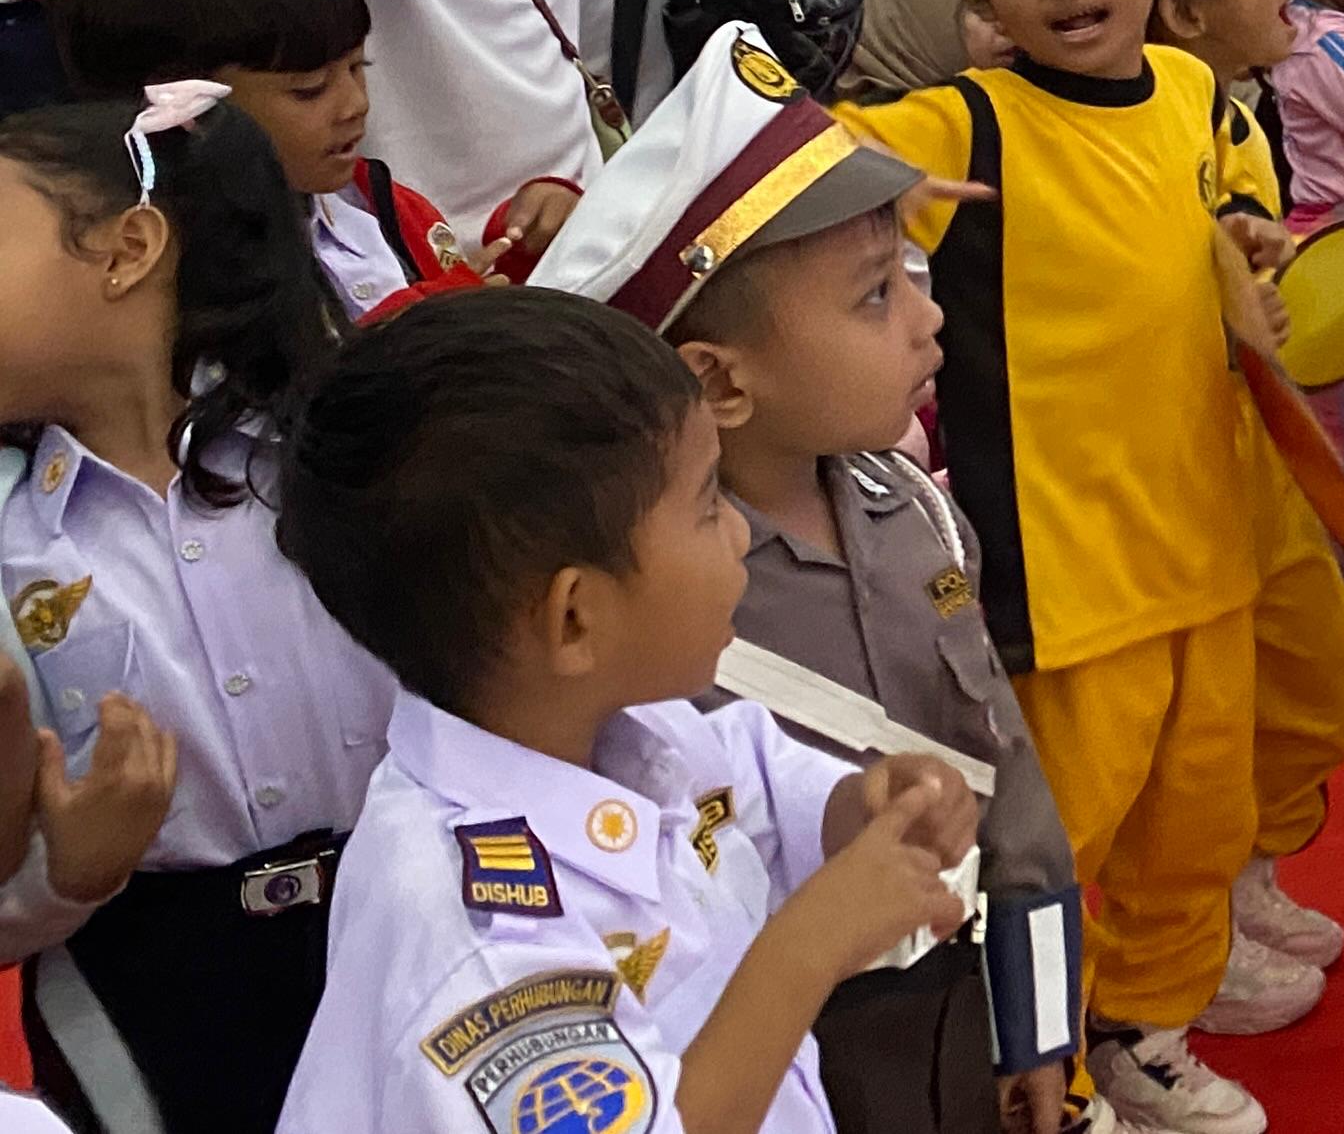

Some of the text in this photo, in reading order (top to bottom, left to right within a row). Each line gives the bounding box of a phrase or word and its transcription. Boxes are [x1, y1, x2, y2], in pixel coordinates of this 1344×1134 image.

[472, 882, 549, 907] DISHUB
[438, 978, 608, 1058] DINAS PERHUBUNGAN
[473, 1023, 610, 1094] PERHUBUNGAN
